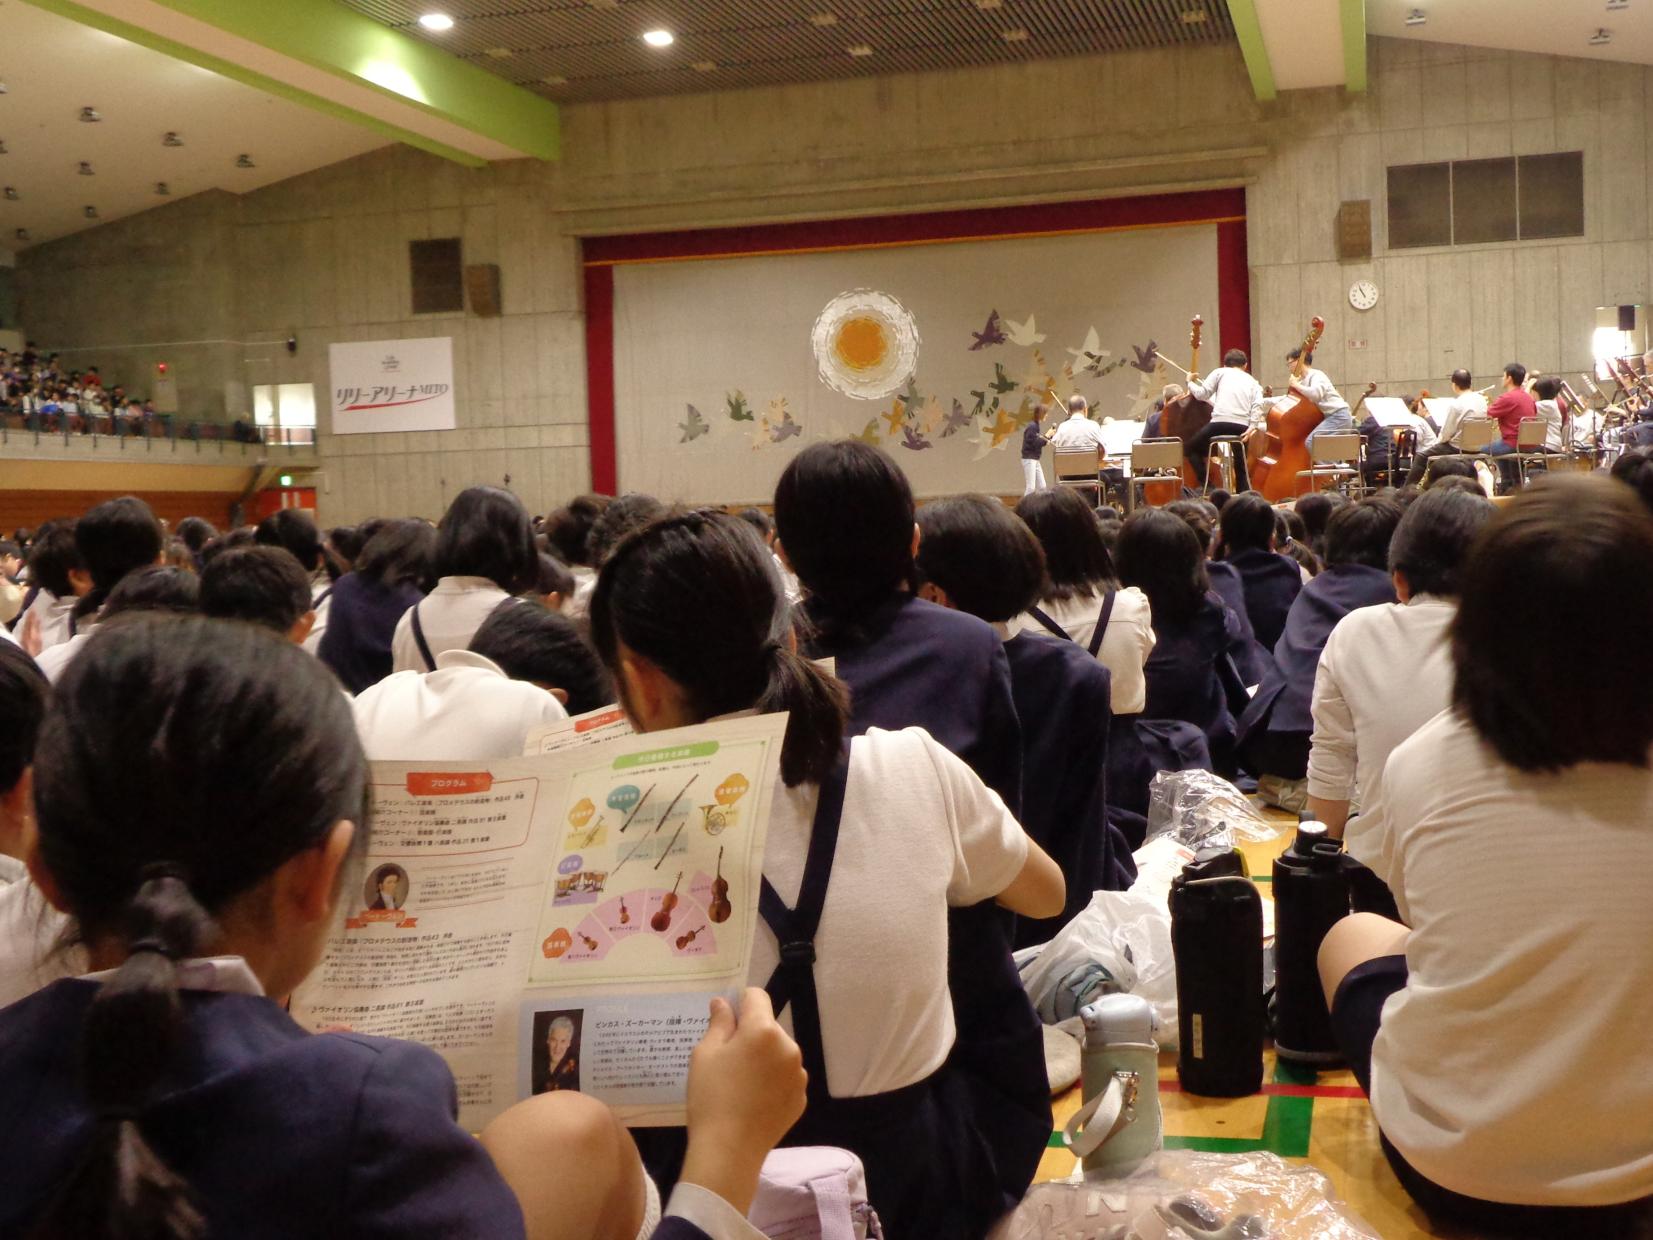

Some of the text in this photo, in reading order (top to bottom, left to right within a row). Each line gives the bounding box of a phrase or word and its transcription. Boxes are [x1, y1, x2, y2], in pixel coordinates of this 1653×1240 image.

[431, 779, 467, 787] プログラム
